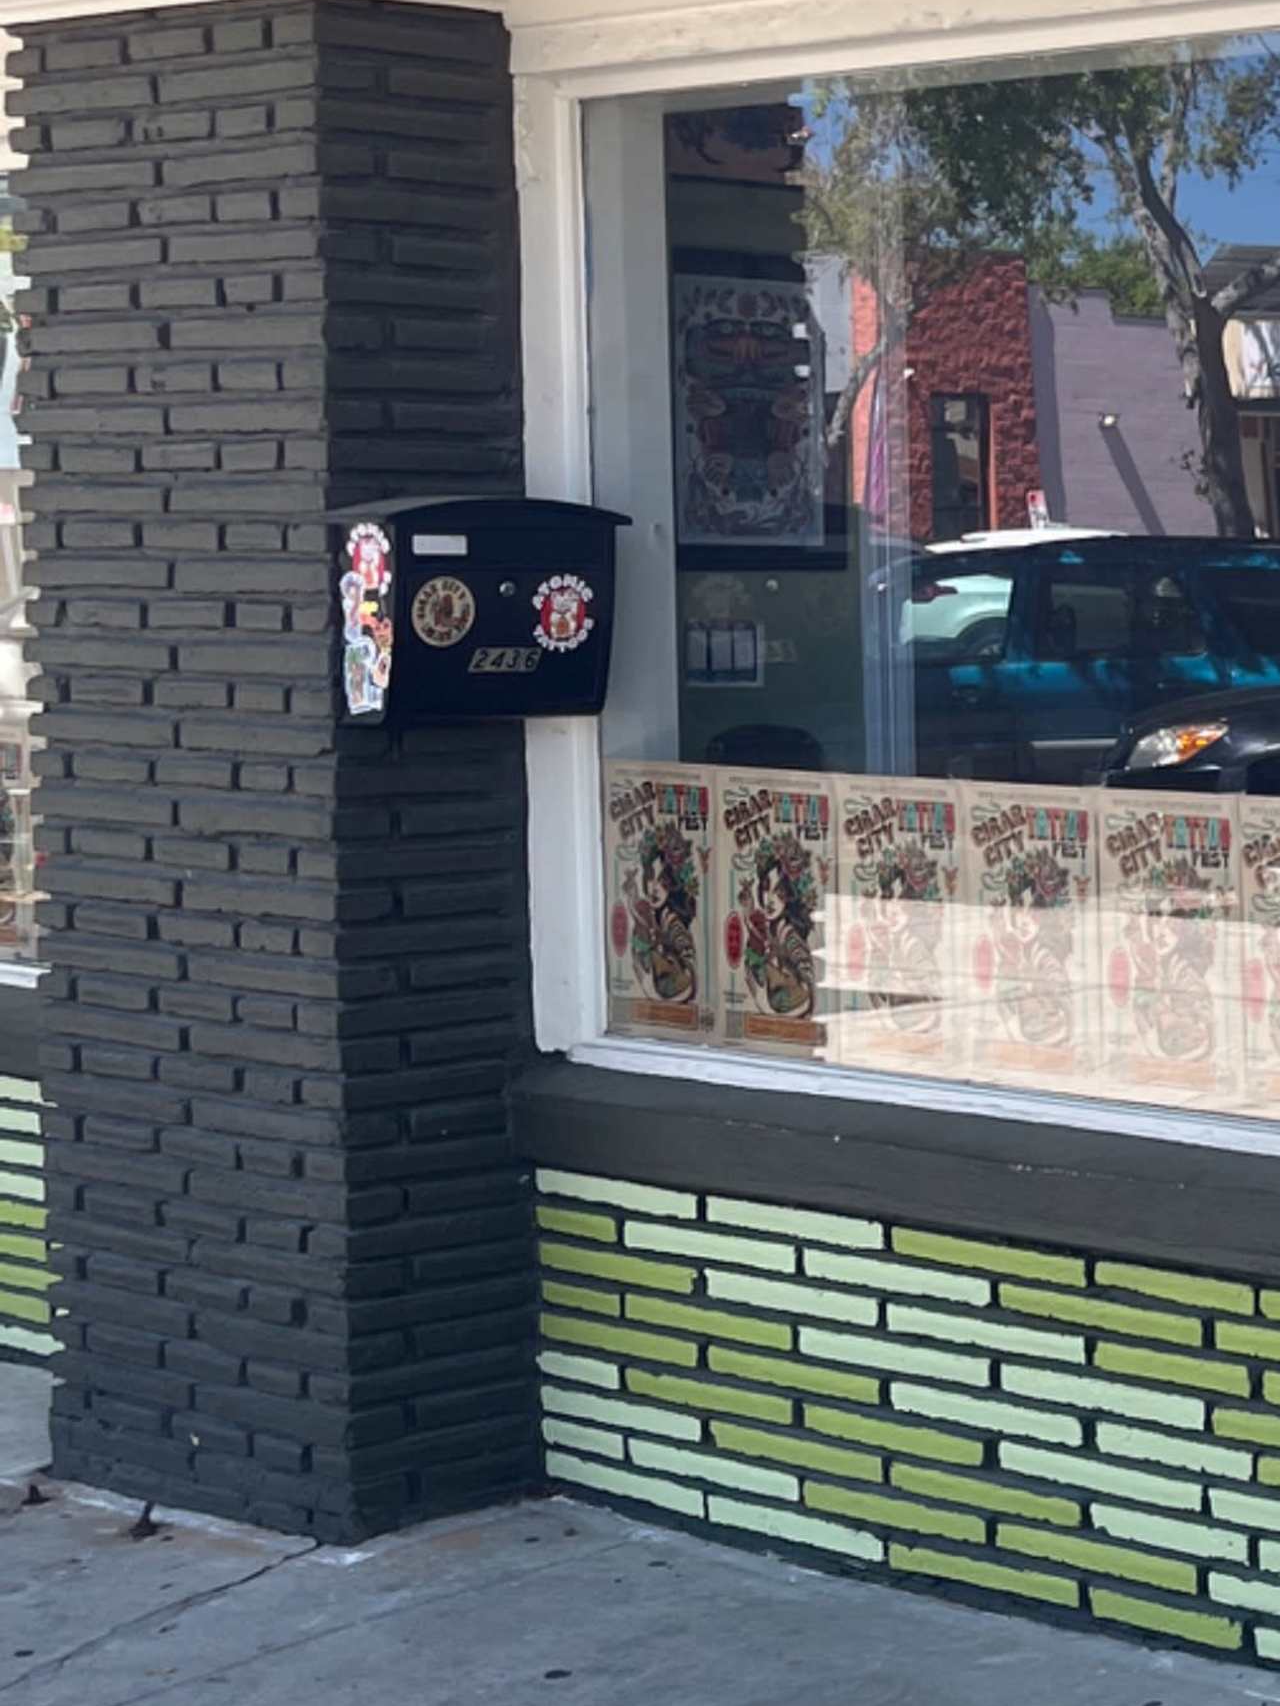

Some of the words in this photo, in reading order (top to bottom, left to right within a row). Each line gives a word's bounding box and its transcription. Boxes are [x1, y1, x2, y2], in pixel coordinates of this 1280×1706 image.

[532, 573, 593, 611] ATOMIC
[471, 649, 539, 671] 2436
[1118, 838, 1164, 878] CITY
